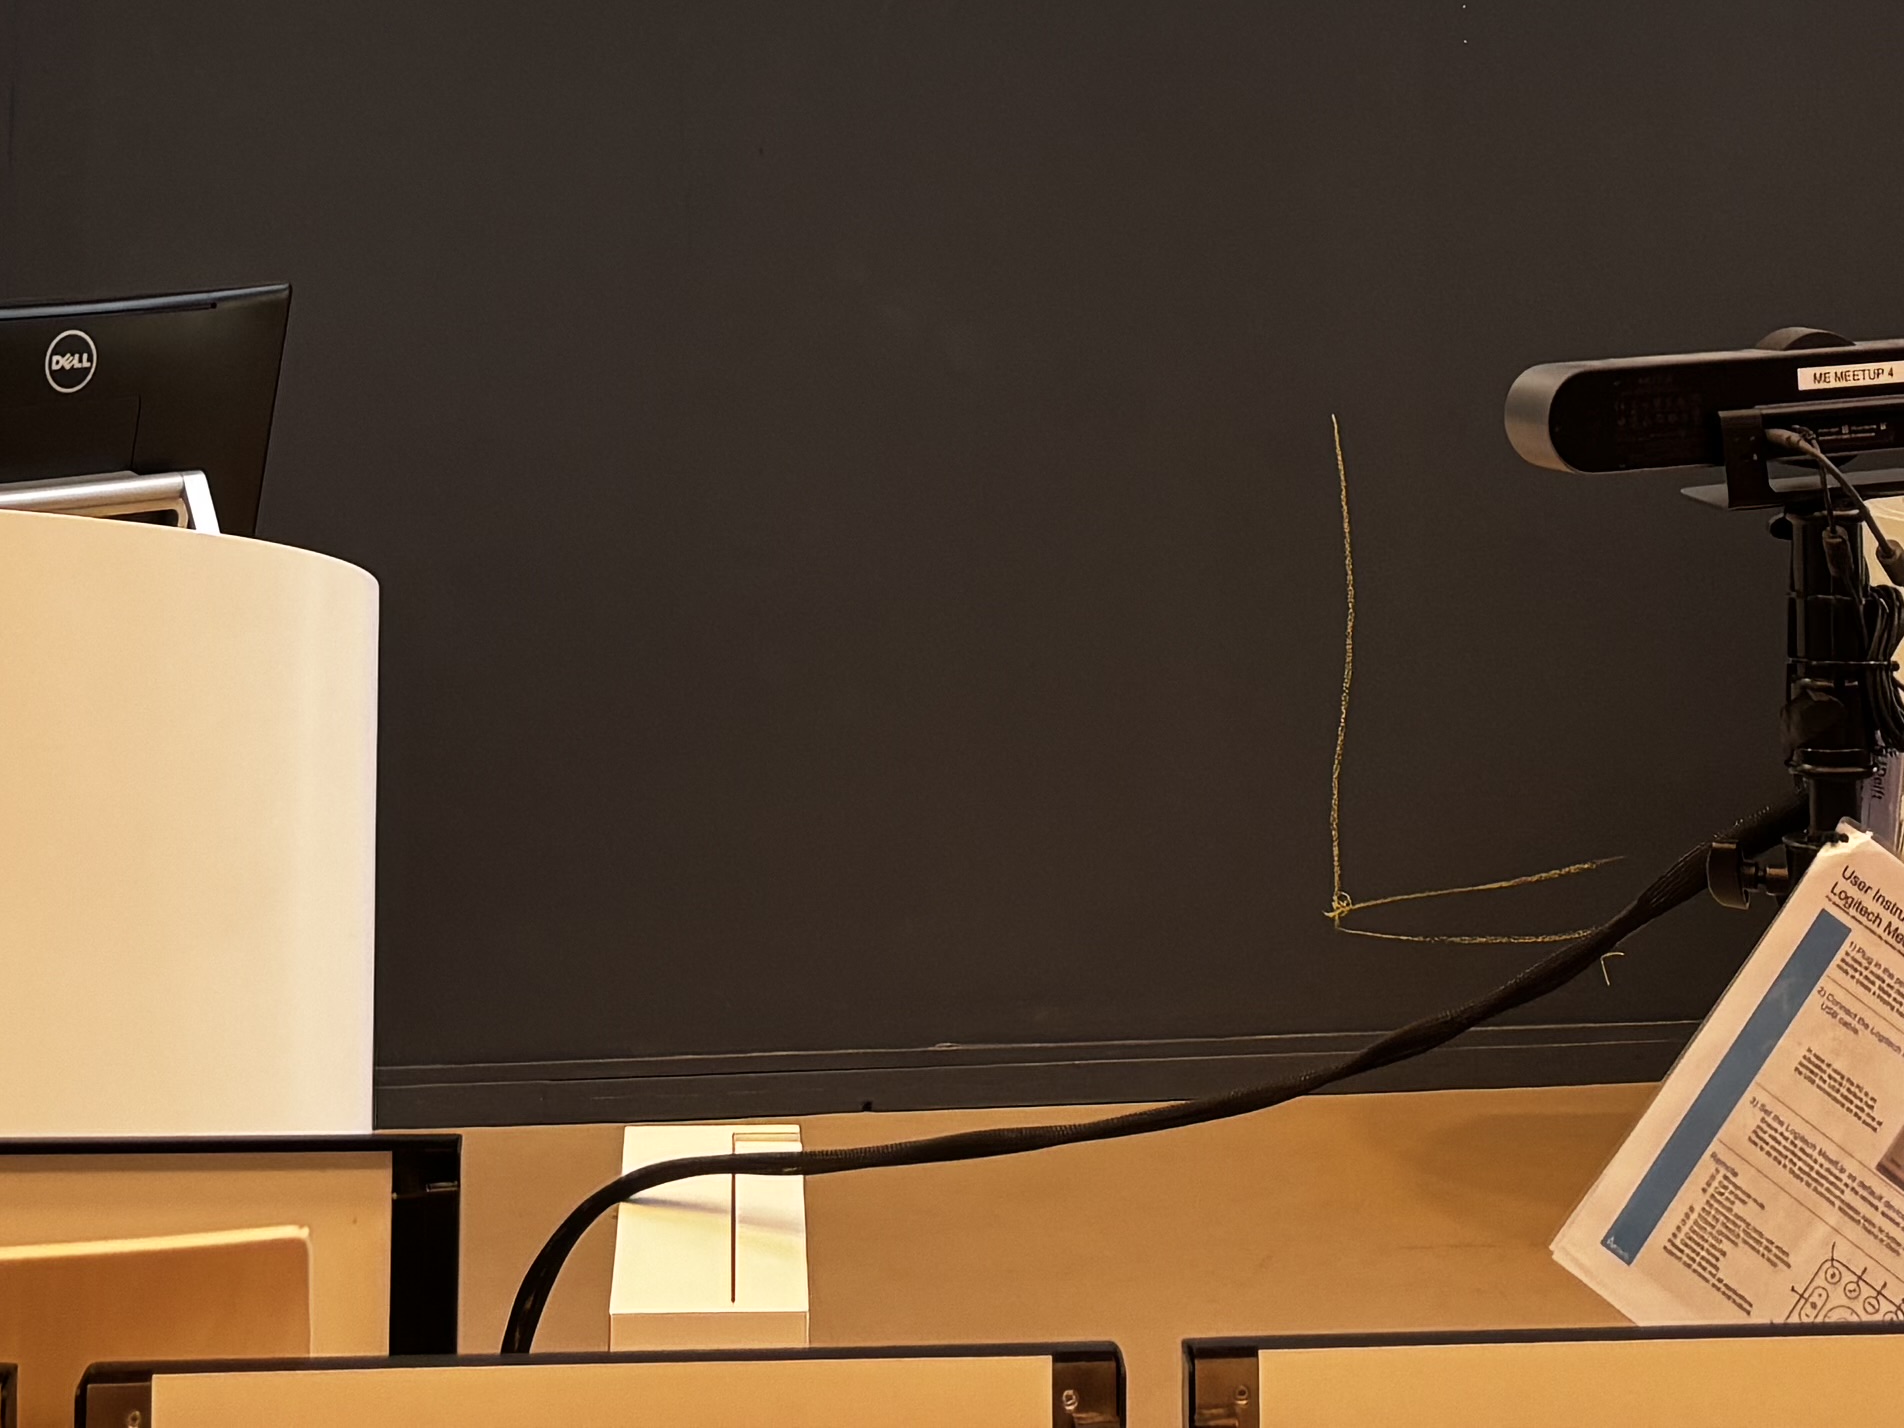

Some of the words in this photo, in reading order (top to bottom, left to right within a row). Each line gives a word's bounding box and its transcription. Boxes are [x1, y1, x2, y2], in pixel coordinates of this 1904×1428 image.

[51, 352, 91, 371] DELL
[1834, 367, 1884, 383] MEETUP
[1888, 367, 1894, 378] 4
[1842, 864, 1873, 895] User
[1830, 881, 1883, 929] Logitech
